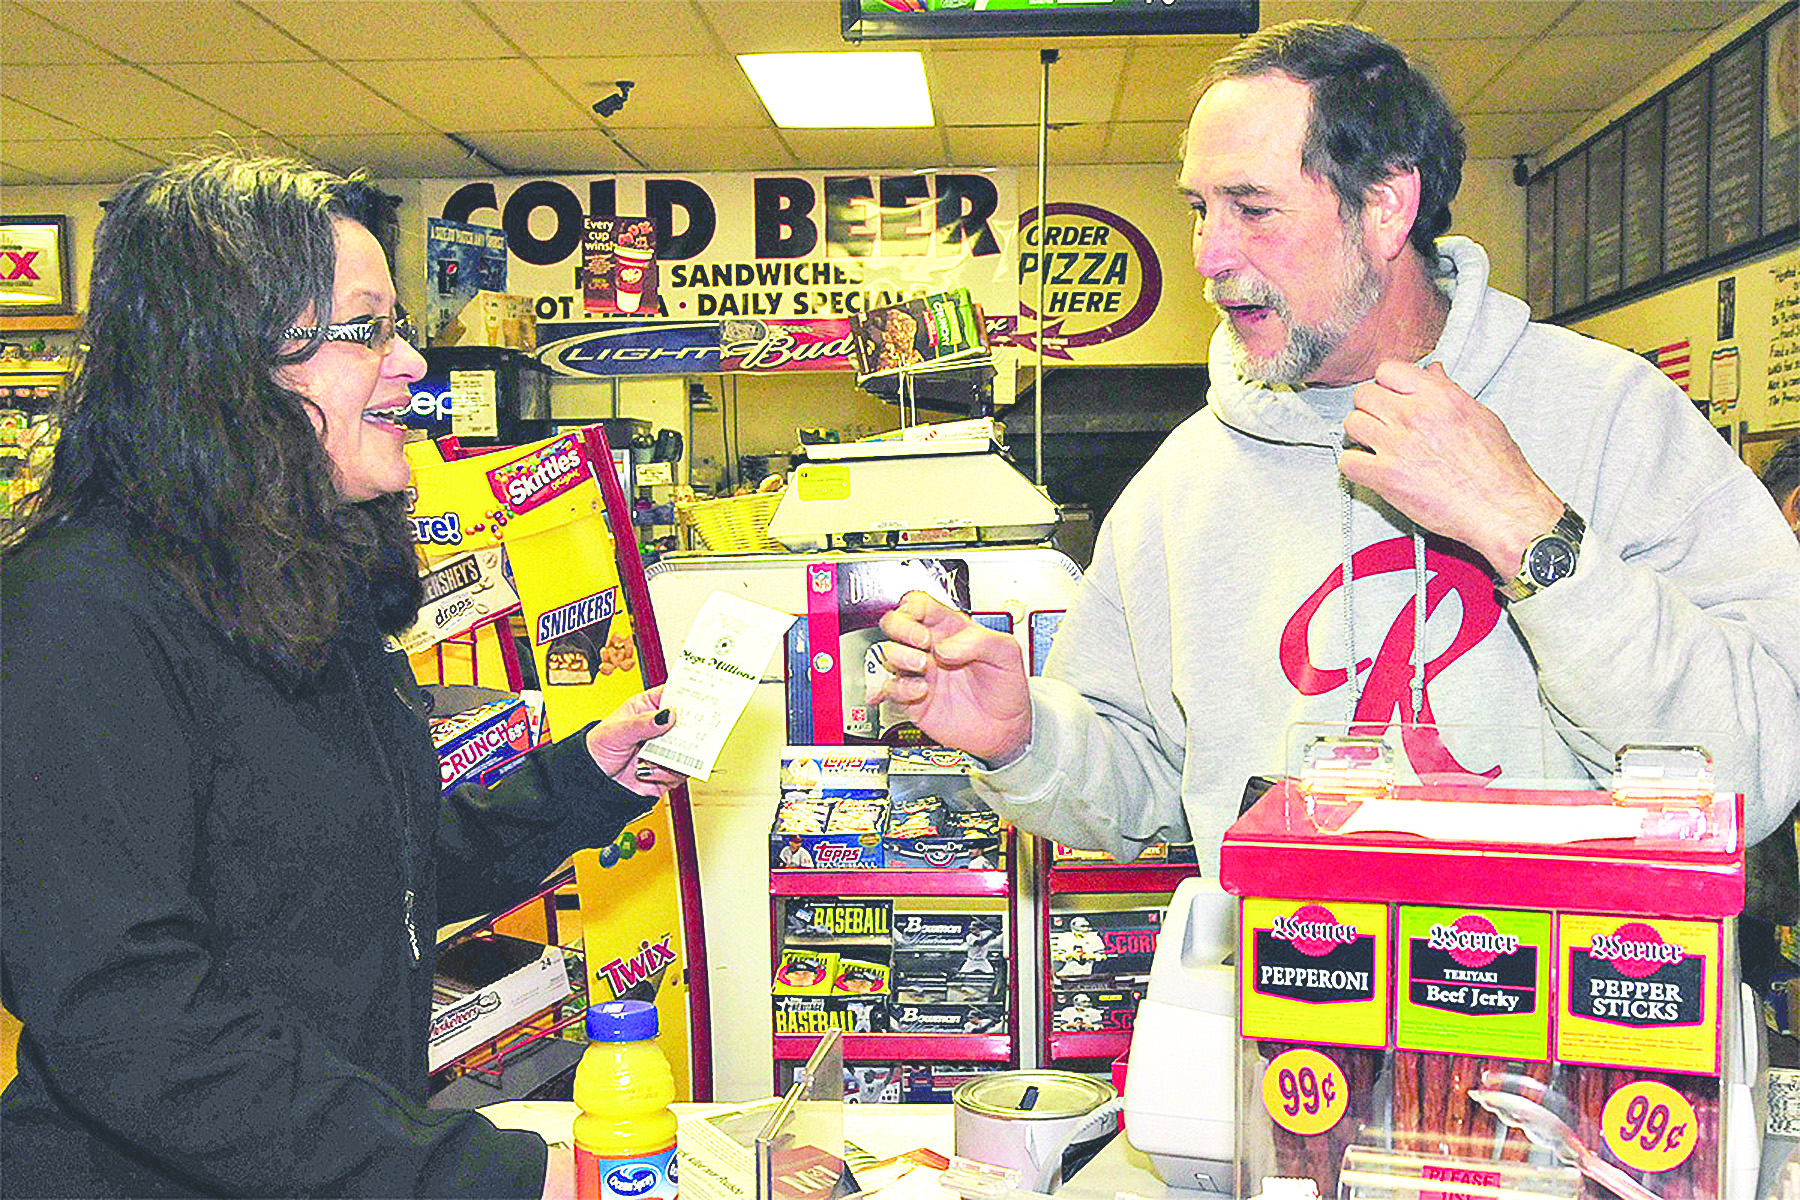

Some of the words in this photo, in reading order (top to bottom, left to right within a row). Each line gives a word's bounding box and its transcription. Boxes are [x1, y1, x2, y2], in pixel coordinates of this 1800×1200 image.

[584, 218, 613, 232] Every
[754, 174, 1001, 259] BEER
[584, 242, 613, 251] wins!
[589, 232, 609, 241] cup
[1026, 225, 1110, 246] ORDER
[671, 262, 864, 288] SANDWICHES
[1019, 252, 1128, 285] PIZZA
[535, 296, 574, 319] OT
[698, 292, 783, 316] DAILY
[1049, 291, 1122, 313] HERE
[566, 346, 721, 361] LIGHT
[508, 450, 581, 505] Skittles
[435, 598, 473, 625] drops
[540, 590, 614, 642] SNICKERS
[1279, 535, 1502, 787] R
[440, 723, 508, 783] CRUNCH
[813, 907, 890, 934] BASEBALL
[903, 916, 962, 934] Bowman
[1271, 914, 1358, 943] Werner
[1428, 924, 1520, 955] Werner
[1589, 933, 1685, 964] Werner
[600, 937, 677, 999] Twix
[1261, 965, 1369, 991] PEPPERONI
[1444, 968, 1498, 983] TERIYAKI
[1427, 984, 1468, 1004] Beef
[1470, 985, 1520, 1011] Jerky
[1590, 978, 1683, 1003] PEPPER
[775, 1010, 855, 1032] BASEBALL
[900, 1007, 961, 1024] Bowman
[1592, 997, 1679, 1021] STICKS
[1278, 1066, 1337, 1117] 99¢
[1619, 1094, 1688, 1153] 99¢
